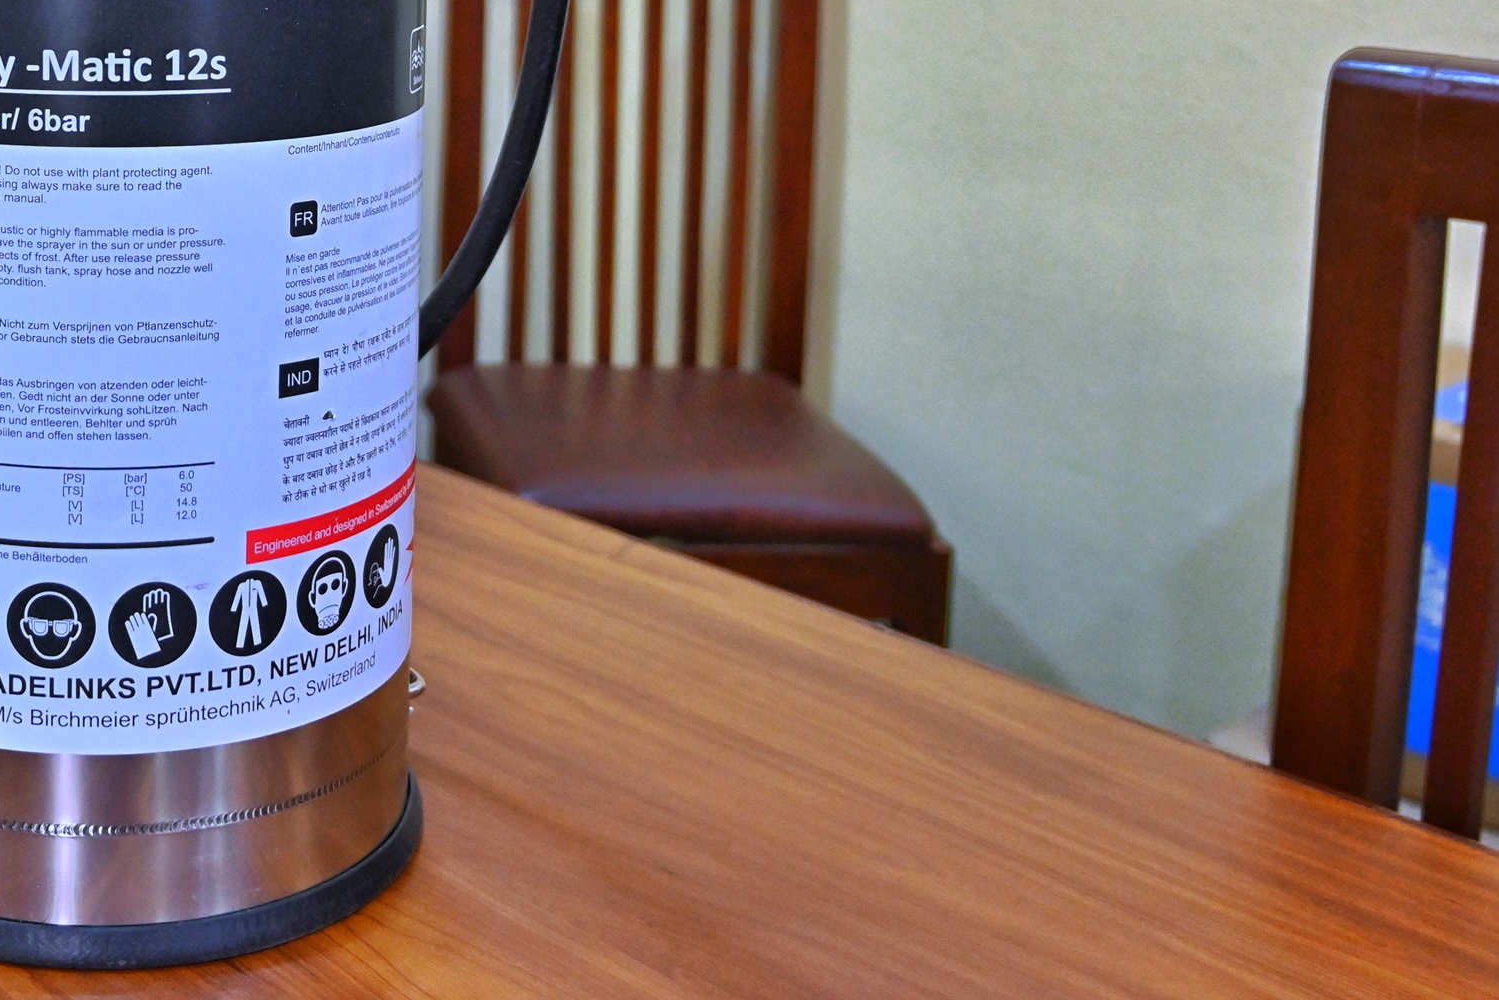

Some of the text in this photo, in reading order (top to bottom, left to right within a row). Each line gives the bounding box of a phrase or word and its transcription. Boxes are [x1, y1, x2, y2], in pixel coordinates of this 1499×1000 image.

[26, 48, 152, 82] -Matic
[166, 48, 227, 81] 12s
[28, 108, 90, 132] 6bar
[5, 164, 21, 176] Do
[23, 167, 41, 177] not
[43, 169, 64, 177] use
[66, 167, 89, 178] with
[92, 167, 120, 180] plant
[123, 167, 177, 180] protecting
[180, 165, 213, 179] agent.
[21, 179, 59, 193] always
[62, 181, 92, 191] make
[96, 183, 120, 191] sure
[123, 181, 134, 191] to
[137, 180, 162, 191] read
[165, 180, 182, 190] the
[4, 194, 47, 204] manual.
[294, 211, 314, 227] FR
[26, 228, 38, 236] or
[40, 226, 71, 239] highly
[74, 227, 129, 237] flammable
[132, 227, 164, 237] media
[167, 226, 176, 236] is
[178, 227, 199, 238] pro-
[17, 238, 33, 249] the
[36, 241, 76, 252] sprayer
[79, 240, 88, 250] in
[91, 240, 108, 250] the
[111, 242, 130, 250] sun
[133, 242, 144, 250] or
[146, 239, 177, 250] under
[179, 238, 226, 250] pressure.
[22, 251, 33, 261] of
[34, 251, 61, 262] frost.
[63, 253, 89, 263] After
[91, 255, 111, 263] use
[114, 253, 153, 263] release
[155, 252, 200, 264] pressure
[286, 246, 340, 264] Mise en garde
[284, 282, 351, 302] ou sous pression.
[0, 318, 25, 330] Nicht
[27, 322, 50, 330] zum
[114, 323, 134, 332] von
[284, 326, 320, 339] refermer.
[71, 335, 96, 344] stets
[98, 334, 115, 344] die
[287, 369, 311, 388] IND
[62, 472, 86, 485] [PS]
[123, 472, 148, 485] [bar]
[178, 469, 196, 481] 6.0
[62, 485, 84, 498] [TS]
[125, 484, 146, 497] [°C]
[179, 482, 193, 493] 50
[68, 499, 83, 512] [V]
[131, 499, 144, 511] [L]
[176, 496, 198, 508] 14.8
[68, 513, 83, 525] [V]
[131, 513, 144, 525] [L]
[176, 509, 198, 521] 12.0
[254, 530, 313, 554] Engineered
[314, 525, 332, 541] and
[333, 513, 368, 534] designed
[368, 508, 375, 520] in
[12, 550, 88, 564] Behälterboden
[146, 664, 262, 698] PVT.LTD,
[270, 647, 319, 680] NEW
[324, 624, 374, 663] DELHI,
[378, 599, 403, 636] INDIA
[30, 709, 139, 728] Birchmeier
[145, 694, 265, 730] sprühtechnik
[269, 686, 300, 708] AG,
[306, 650, 375, 697] Switzerland
